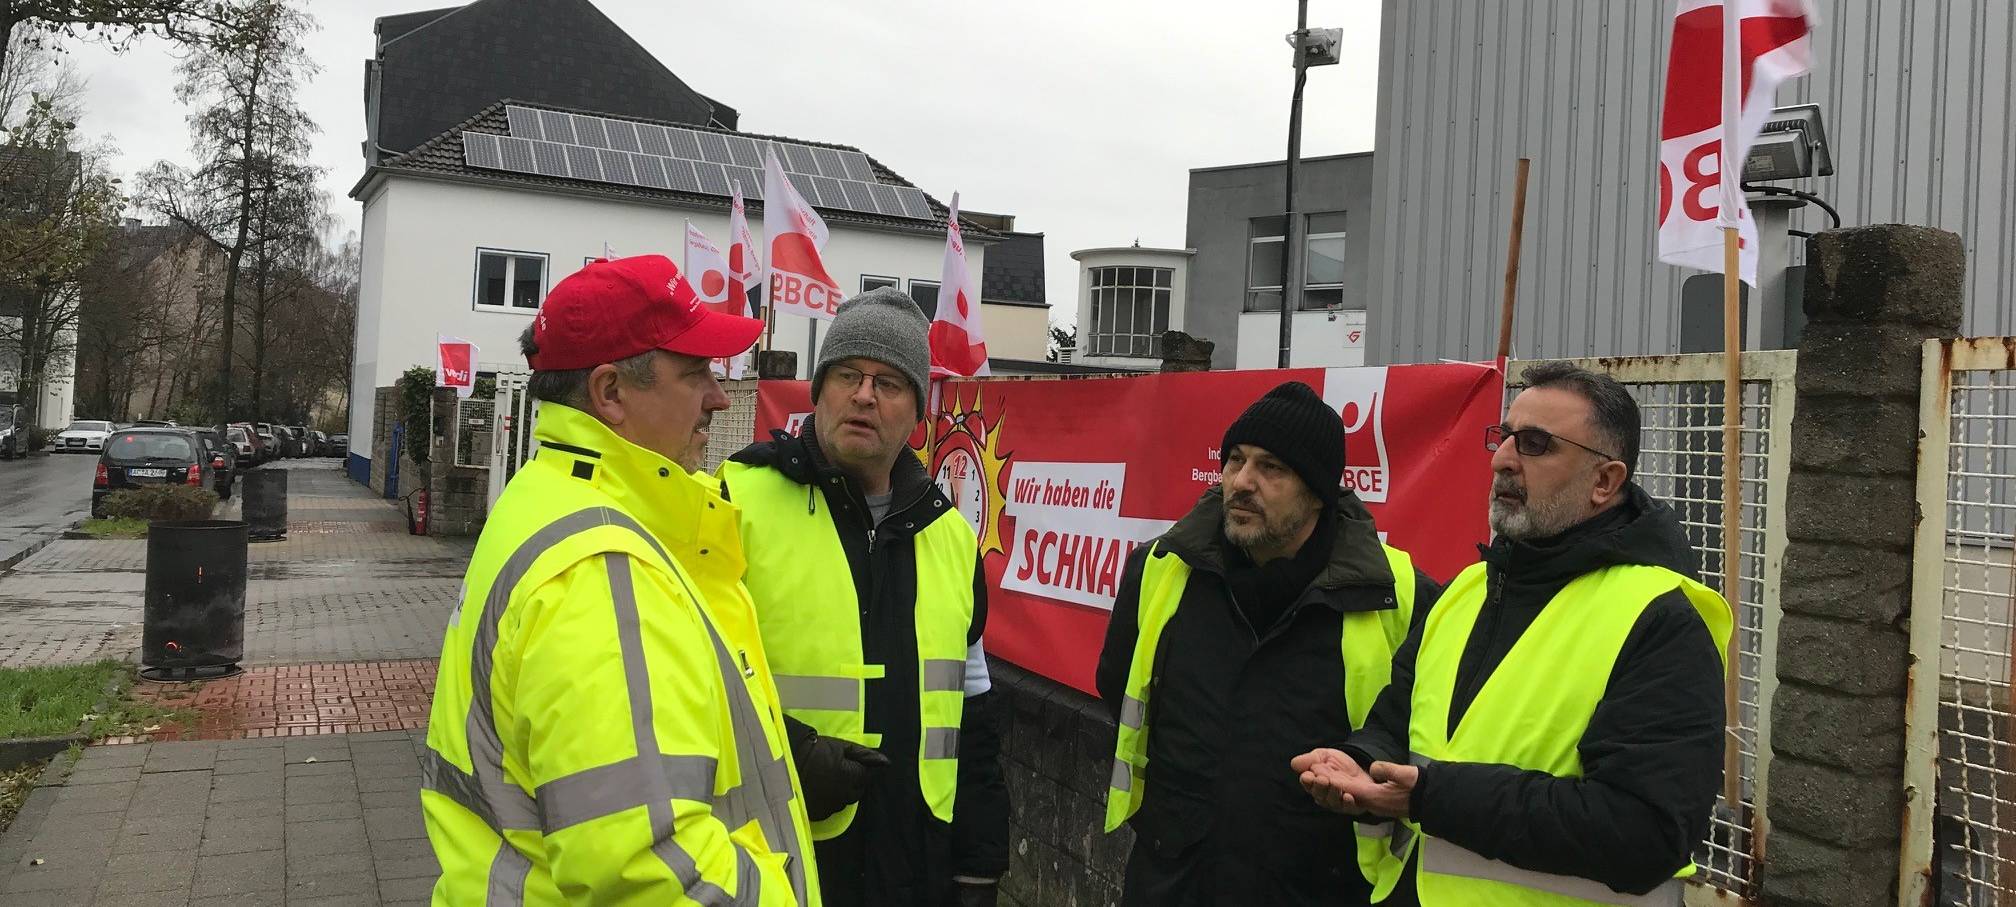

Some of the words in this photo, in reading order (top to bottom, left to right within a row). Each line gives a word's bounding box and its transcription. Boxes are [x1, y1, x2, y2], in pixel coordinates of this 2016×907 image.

[942, 465, 951, 479] 11
[954, 454, 968, 479] 12
[971, 469, 975, 480] 1
[974, 490, 980, 502] 2
[1014, 477, 1042, 504] Wir
[1042, 478, 1090, 508] haben
[1093, 480, 1115, 509] die
[975, 511, 980, 523] 3
